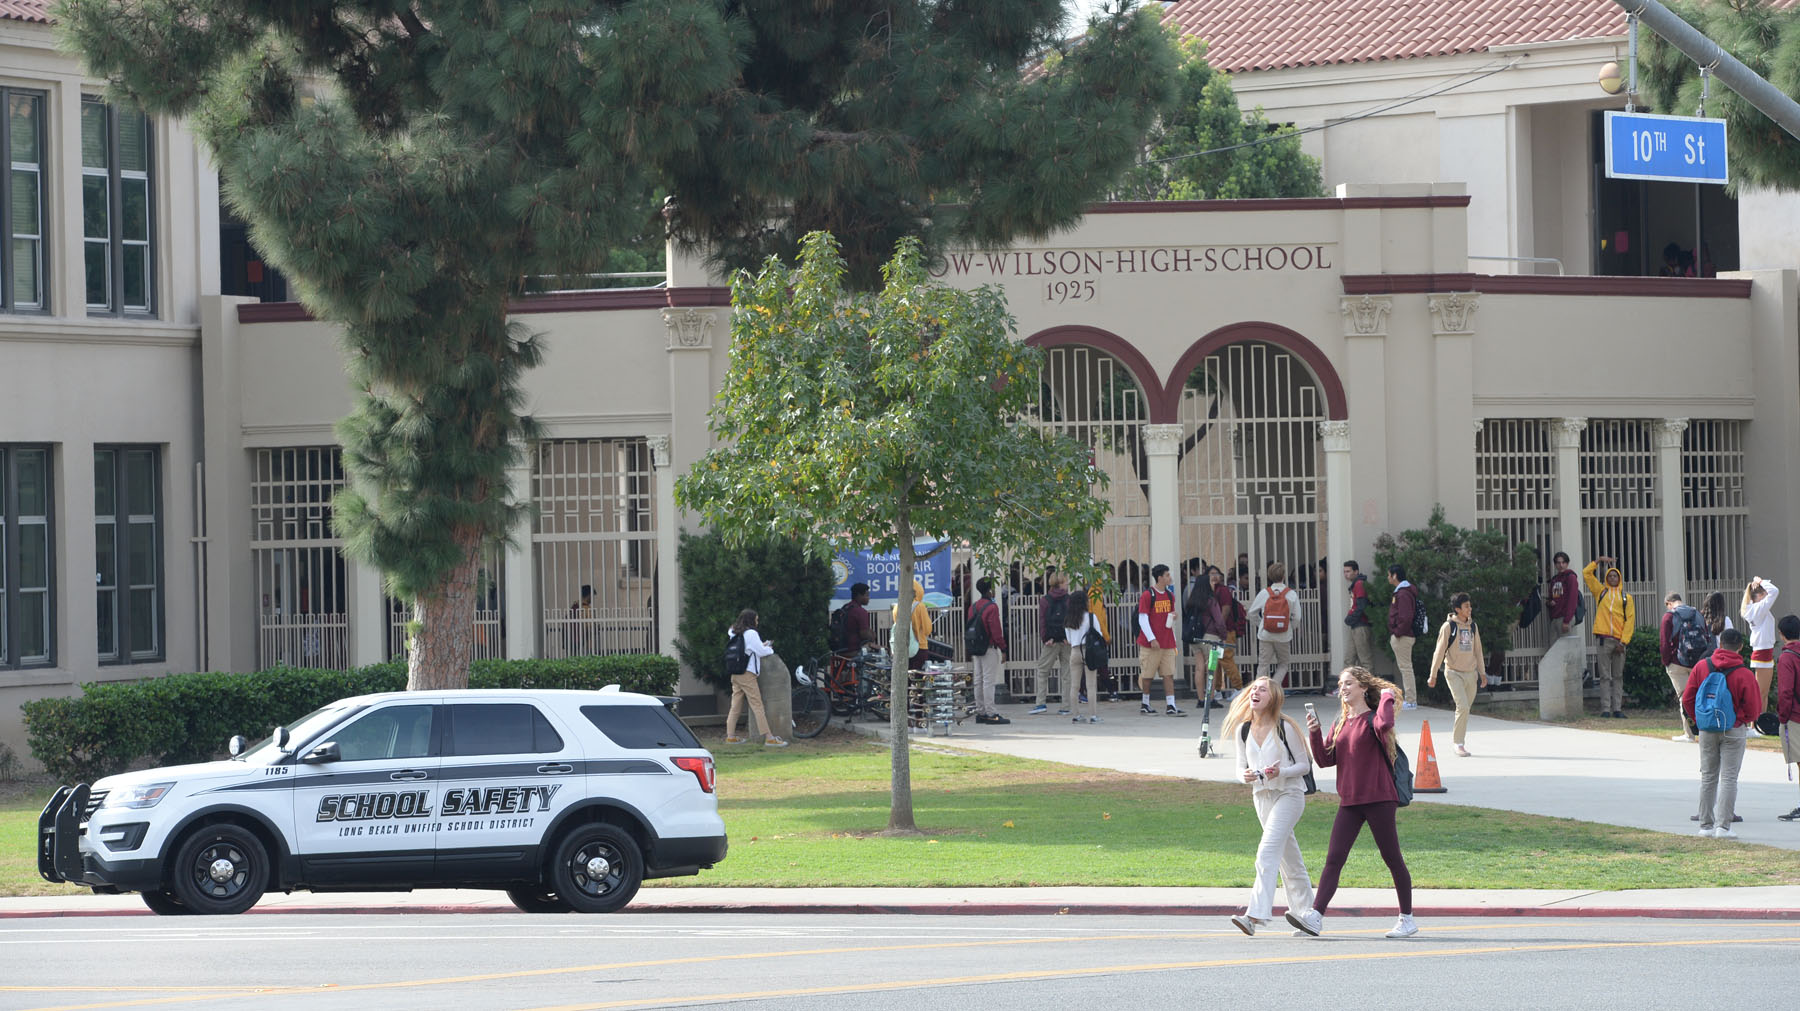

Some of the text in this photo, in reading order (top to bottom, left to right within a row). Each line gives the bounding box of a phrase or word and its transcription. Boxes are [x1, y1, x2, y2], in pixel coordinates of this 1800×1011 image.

[1684, 133, 1706, 165] St
[1047, 280, 1095, 304] 1925
[867, 560, 932, 575] BOOK AIR
[867, 572, 935, 592] IS HRE
[265, 766, 289, 776] 1185
[316, 784, 563, 823] SCHOOL SAFETY
[339, 817, 535, 838] LONG BEACH UNIFIED SCHOOL DISTRICT
